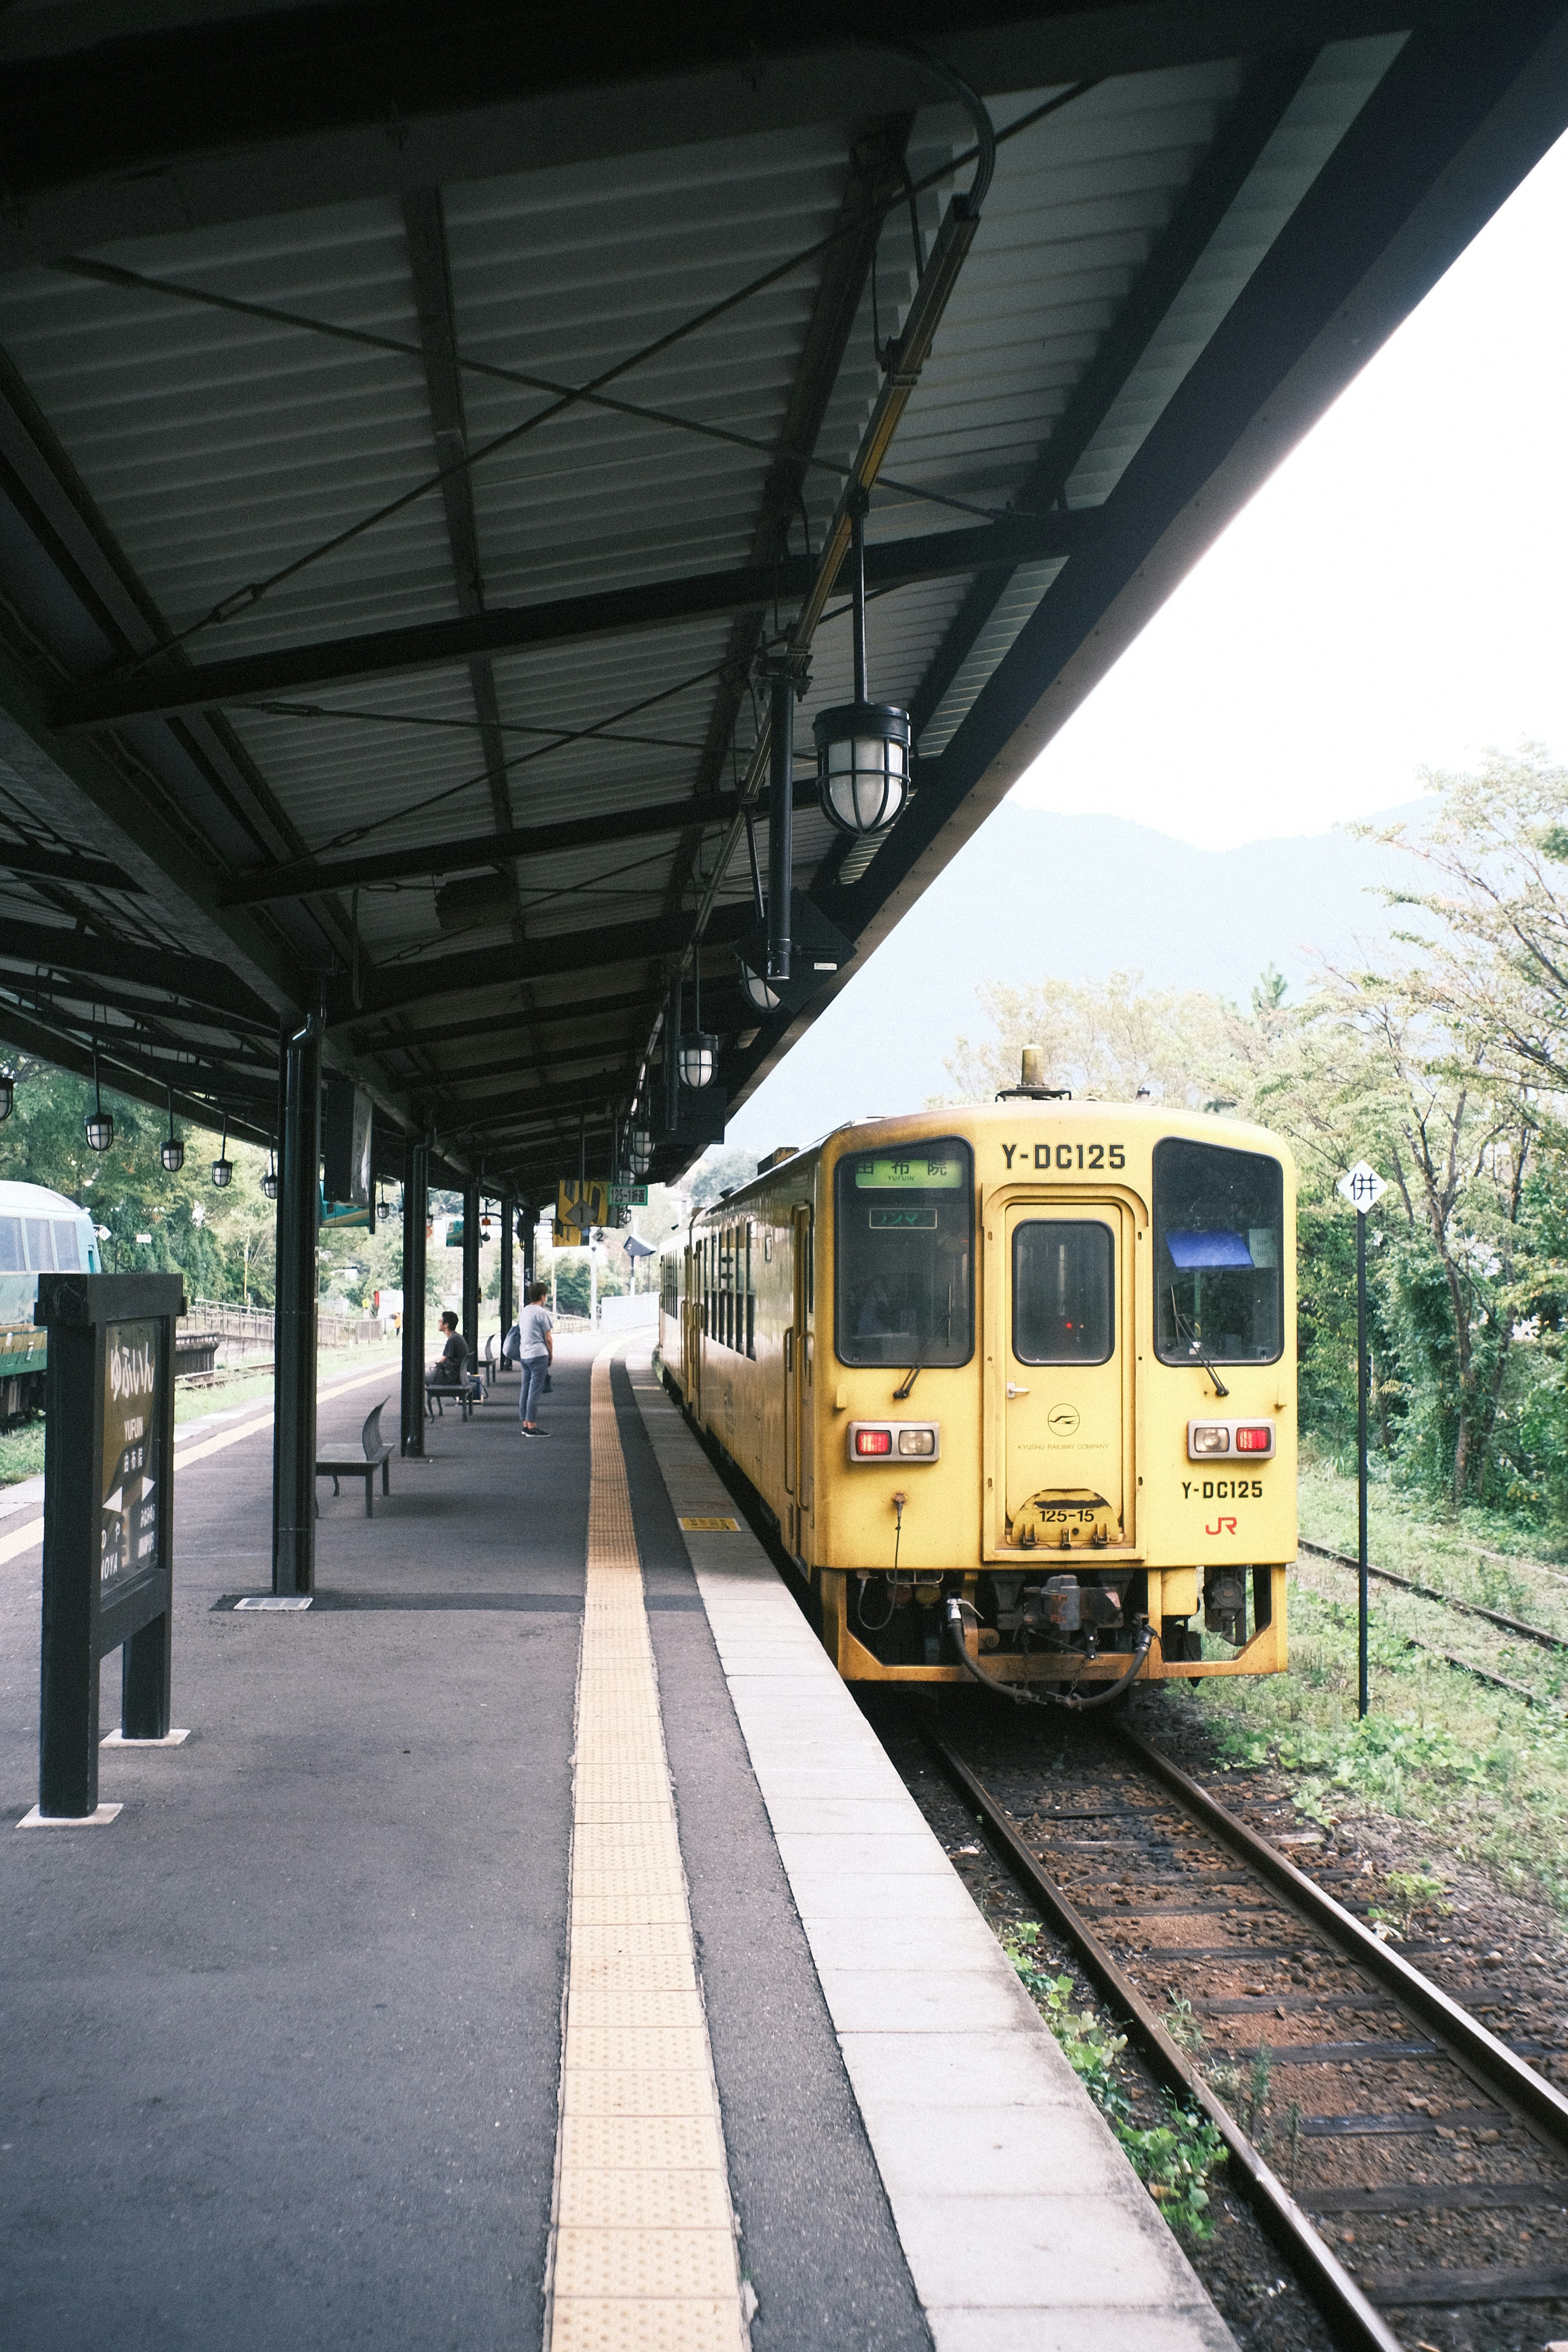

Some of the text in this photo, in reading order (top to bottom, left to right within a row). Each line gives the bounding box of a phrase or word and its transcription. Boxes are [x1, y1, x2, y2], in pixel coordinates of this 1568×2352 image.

[1001, 1144, 1126, 1169] Y-DC125
[1350, 1173, 1378, 1201] 併
[579, 1206, 584, 1223] 1
[596, 1232, 604, 1242] 2
[111, 1342, 154, 1401] ゆふいん
[124, 1416, 143, 1442] YUFUIN
[1182, 1481, 1263, 1499] Y-DC125
[1039, 1510, 1095, 1522] 125-15
[1205, 1517, 1237, 1535] JR
